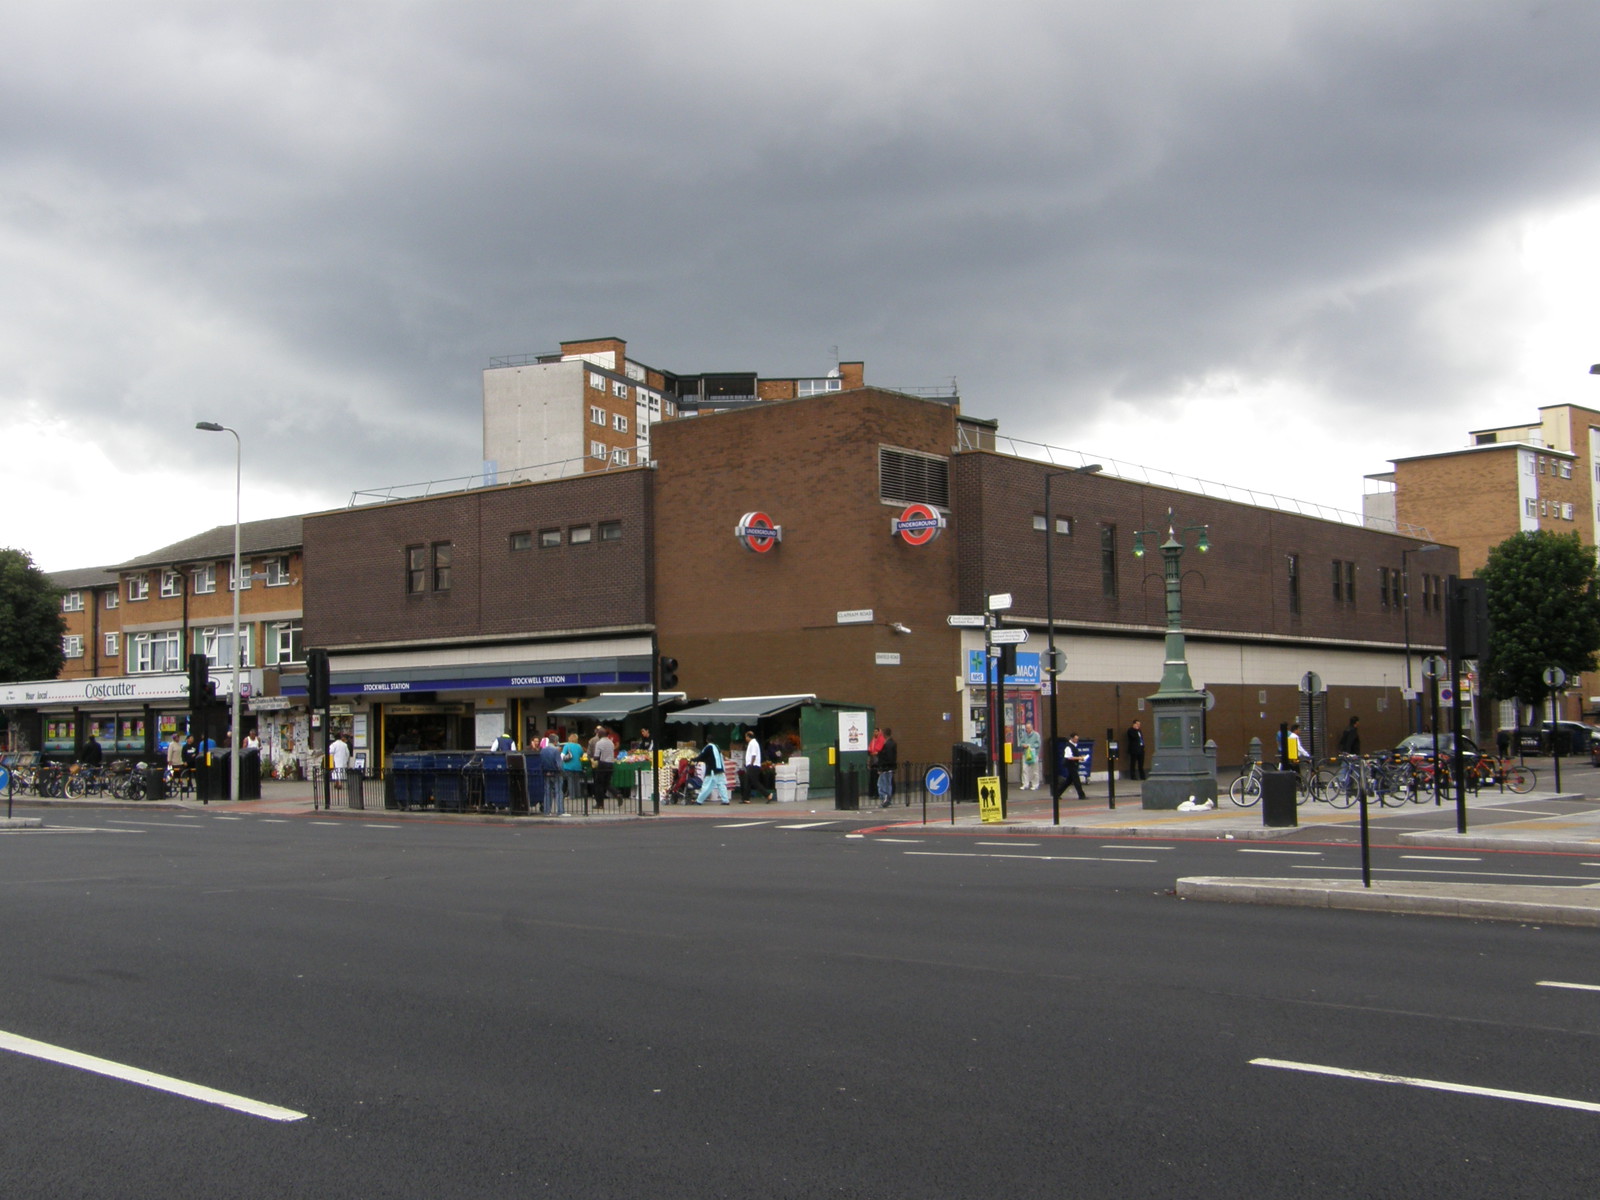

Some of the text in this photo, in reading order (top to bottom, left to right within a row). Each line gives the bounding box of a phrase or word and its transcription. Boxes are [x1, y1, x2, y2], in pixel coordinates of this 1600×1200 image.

[897, 519, 937, 528] UNDERGROUND
[746, 528, 777, 536] UNDERGROUND
[511, 674, 566, 686] STOCKWELL STATION
[972, 673, 983, 681] NHS
[85, 682, 136, 699] Costcutter
[363, 682, 410, 691] STOCKWELL STATION
[37, 691, 48, 699] local
